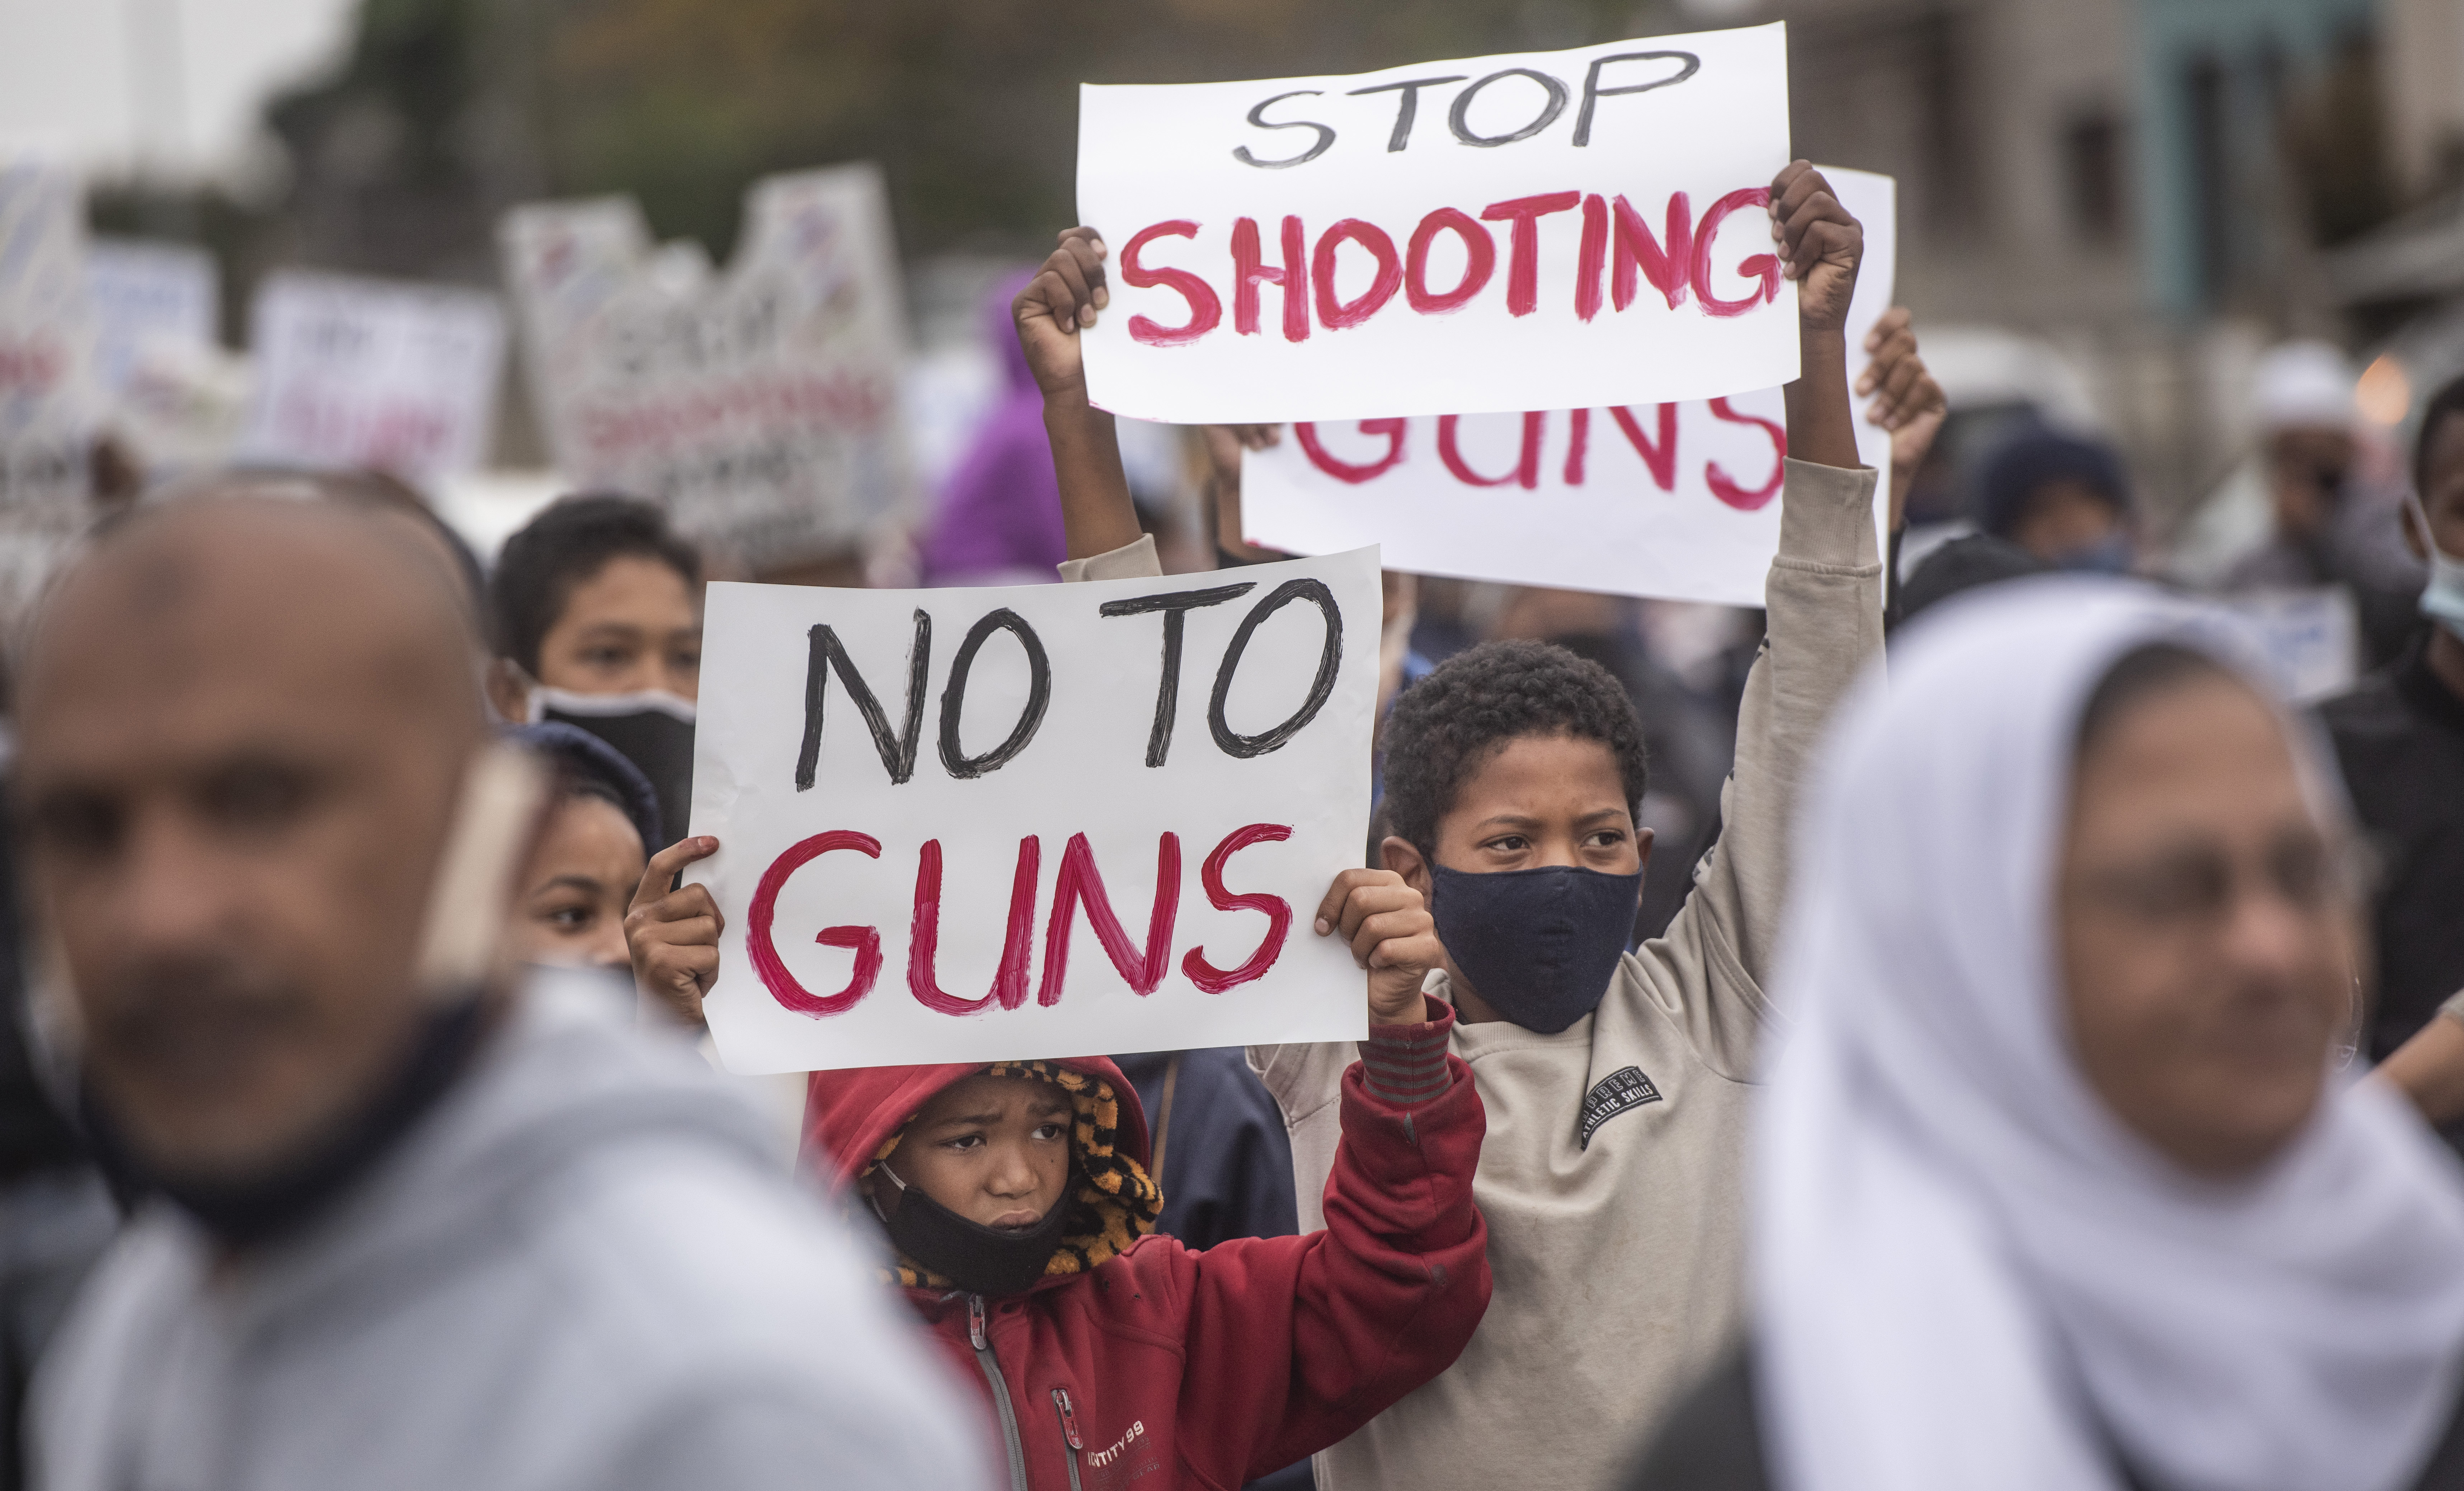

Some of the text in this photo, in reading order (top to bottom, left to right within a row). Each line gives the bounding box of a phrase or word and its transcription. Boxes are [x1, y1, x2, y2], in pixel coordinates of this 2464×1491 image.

[1232, 50, 1701, 169] STOP
[1119, 184, 1783, 348] SHOOTING
[795, 578, 1344, 793] NO TO
[746, 822, 1294, 1020] GUNS
[1582, 1070, 1646, 1122] UPREME
[1583, 1084, 1654, 1138] ATHLETIC SKILLS
